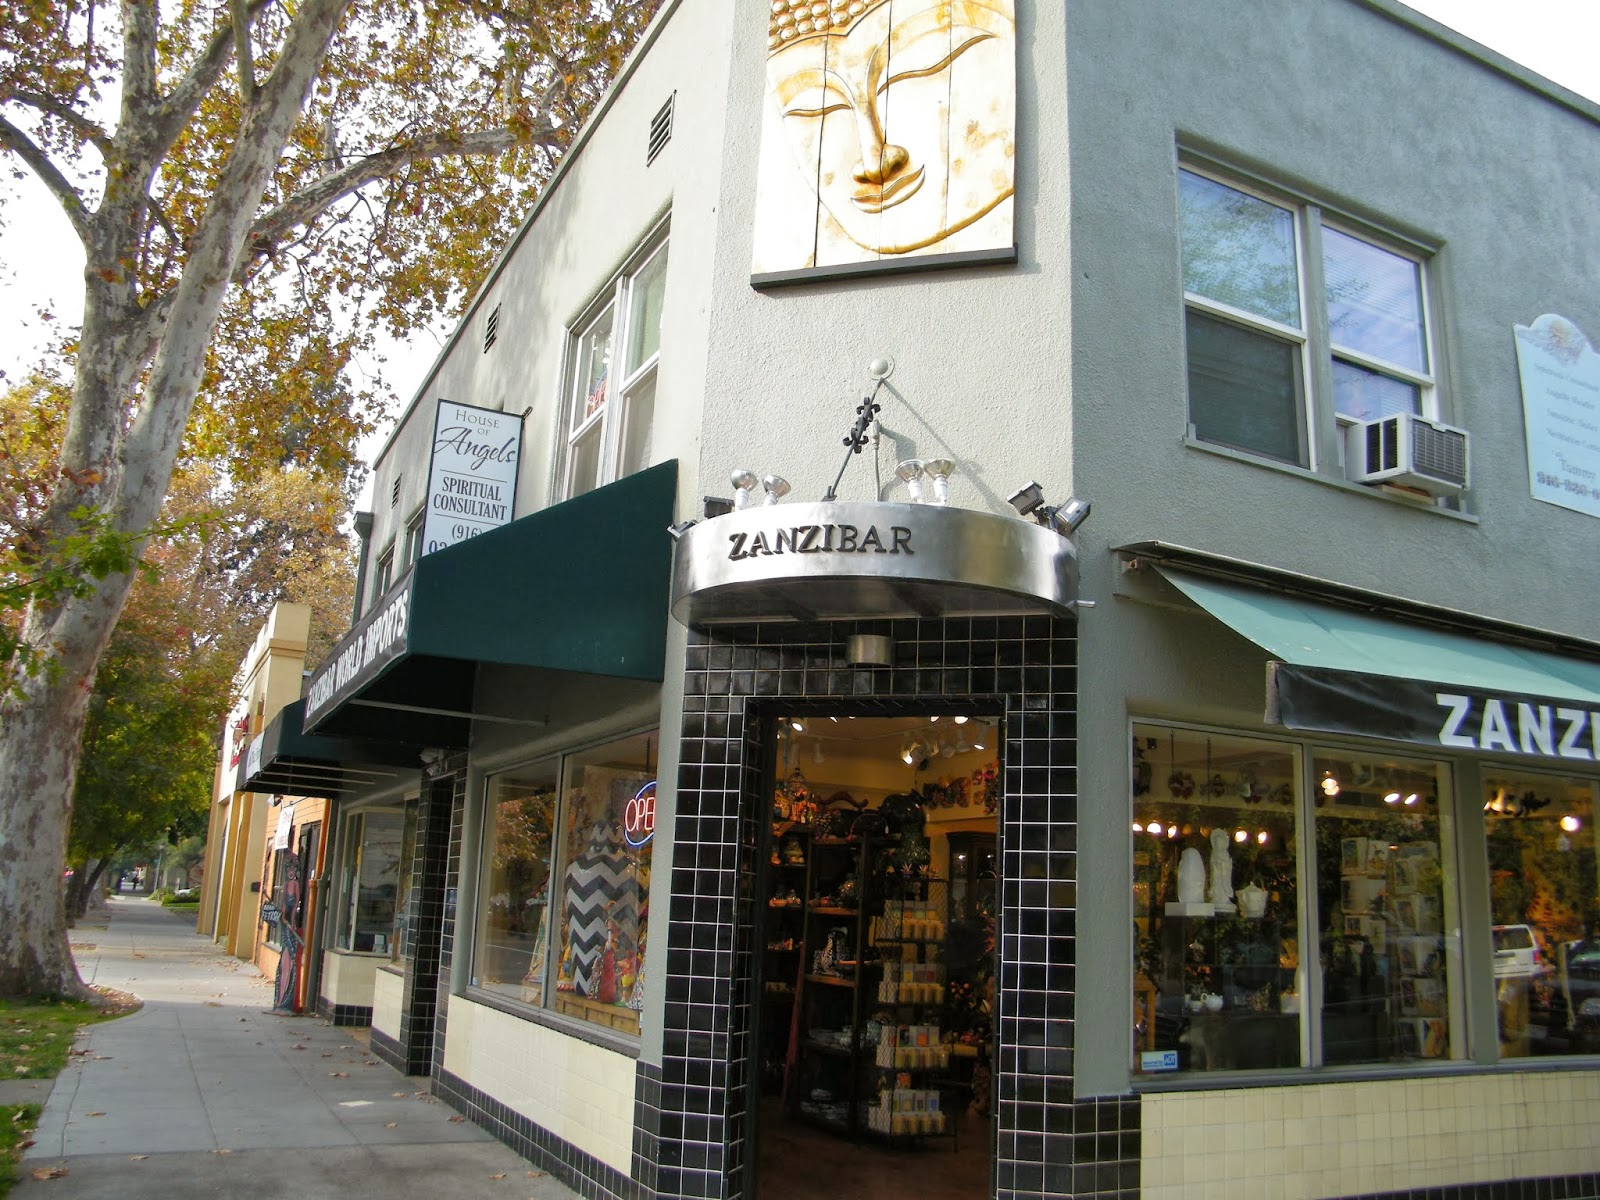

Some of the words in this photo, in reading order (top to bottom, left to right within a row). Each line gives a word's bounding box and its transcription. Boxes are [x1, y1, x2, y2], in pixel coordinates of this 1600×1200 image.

[455, 409, 500, 428] HOUSE
[477, 428, 491, 436] OF
[433, 426, 517, 471] Angels
[442, 476, 502, 502] SPIRITUAL
[433, 493, 508, 521] CONSULTANT
[727, 523, 915, 562] ZANZIBAR
